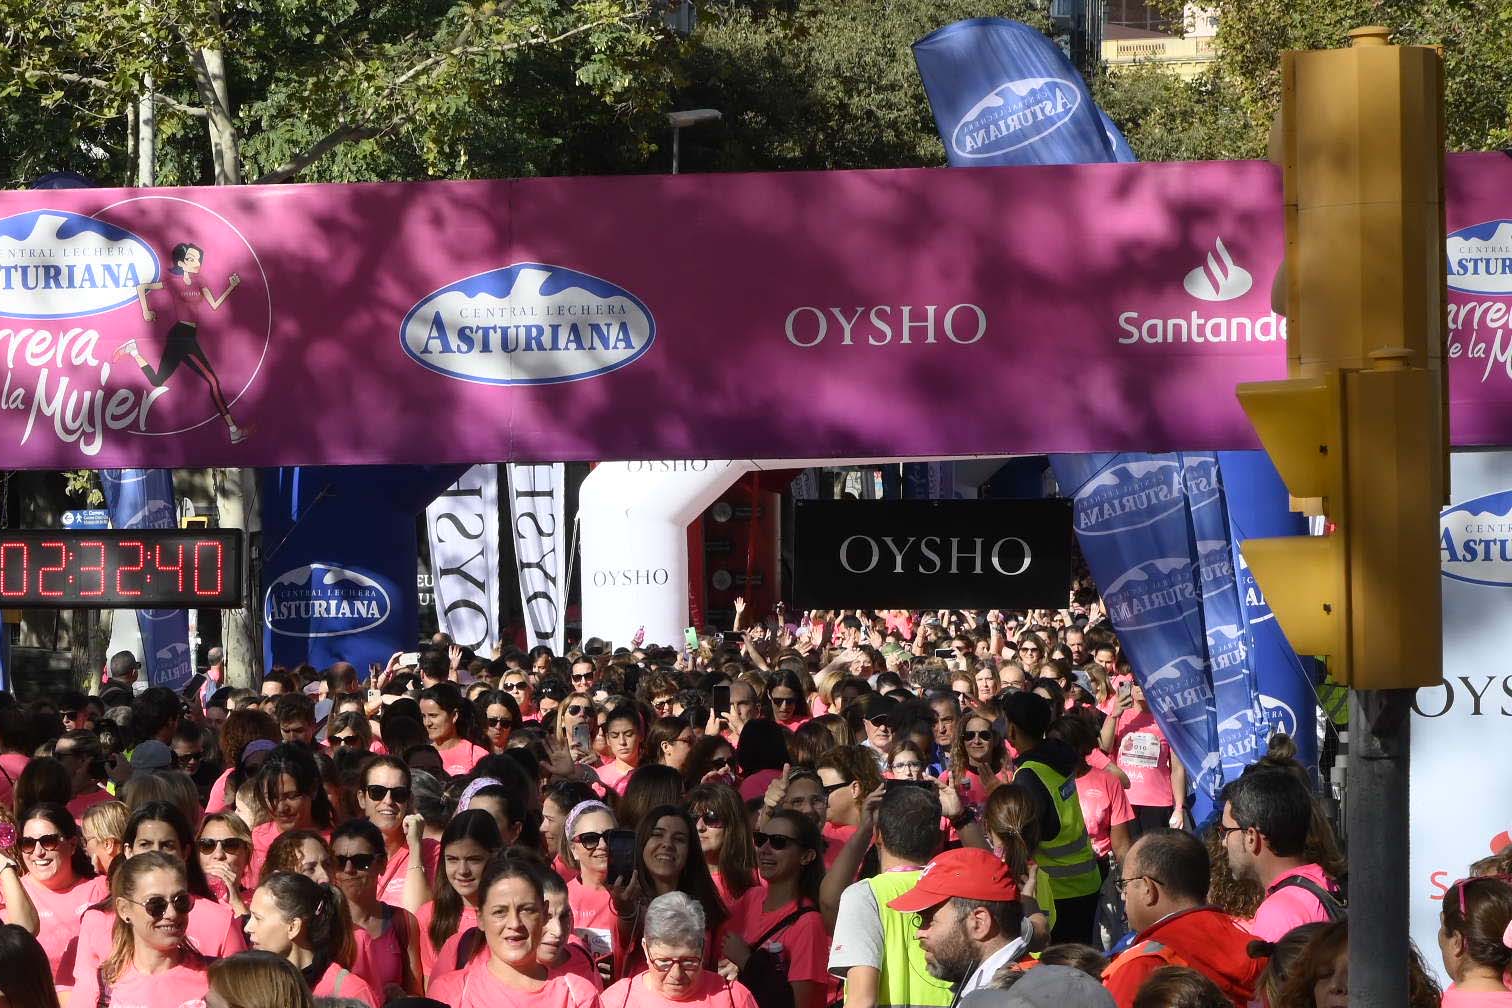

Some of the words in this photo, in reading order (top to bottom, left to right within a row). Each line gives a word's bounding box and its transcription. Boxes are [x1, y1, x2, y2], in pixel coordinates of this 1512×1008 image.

[63, 247, 135, 258] LECHERA
[460, 305, 538, 319] CENTRAL
[546, 303, 628, 317] LECHERA
[785, 302, 988, 348] OYSHO
[419, 310, 636, 355] ASTURIANA
[1468, 328, 1486, 359] la
[1, 370, 27, 411] la
[20, 361, 170, 456] Mujer
[0, 540, 224, 598] 02:32:40
[839, 535, 1032, 577] OYSHO
[593, 567, 670, 588] OYSHO
[268, 593, 382, 622] ASTURIANA
